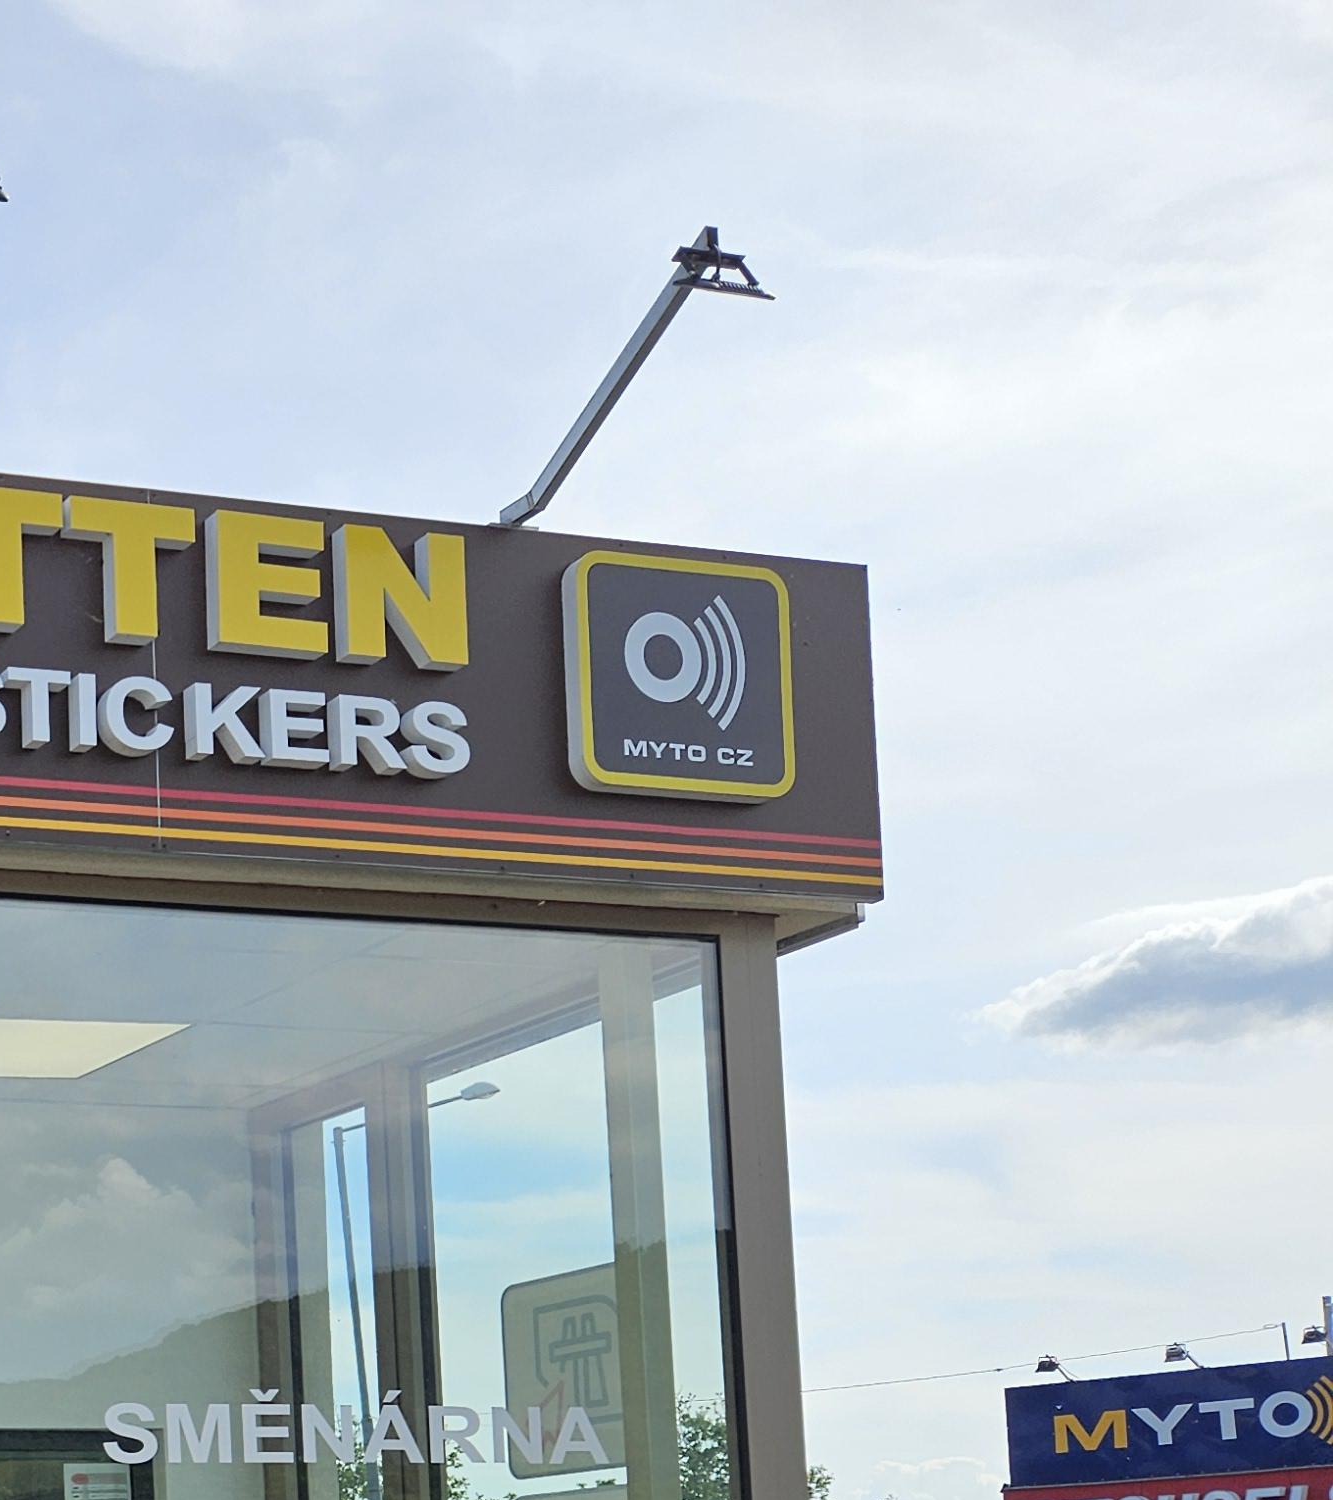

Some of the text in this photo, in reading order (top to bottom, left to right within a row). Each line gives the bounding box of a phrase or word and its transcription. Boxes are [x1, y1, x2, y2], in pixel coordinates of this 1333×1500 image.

[623, 738, 754, 767] MYTO CZ
[102, 1388, 611, 1465] SMĚNÁRNA
[1053, 1391, 1313, 1454] MYTO
